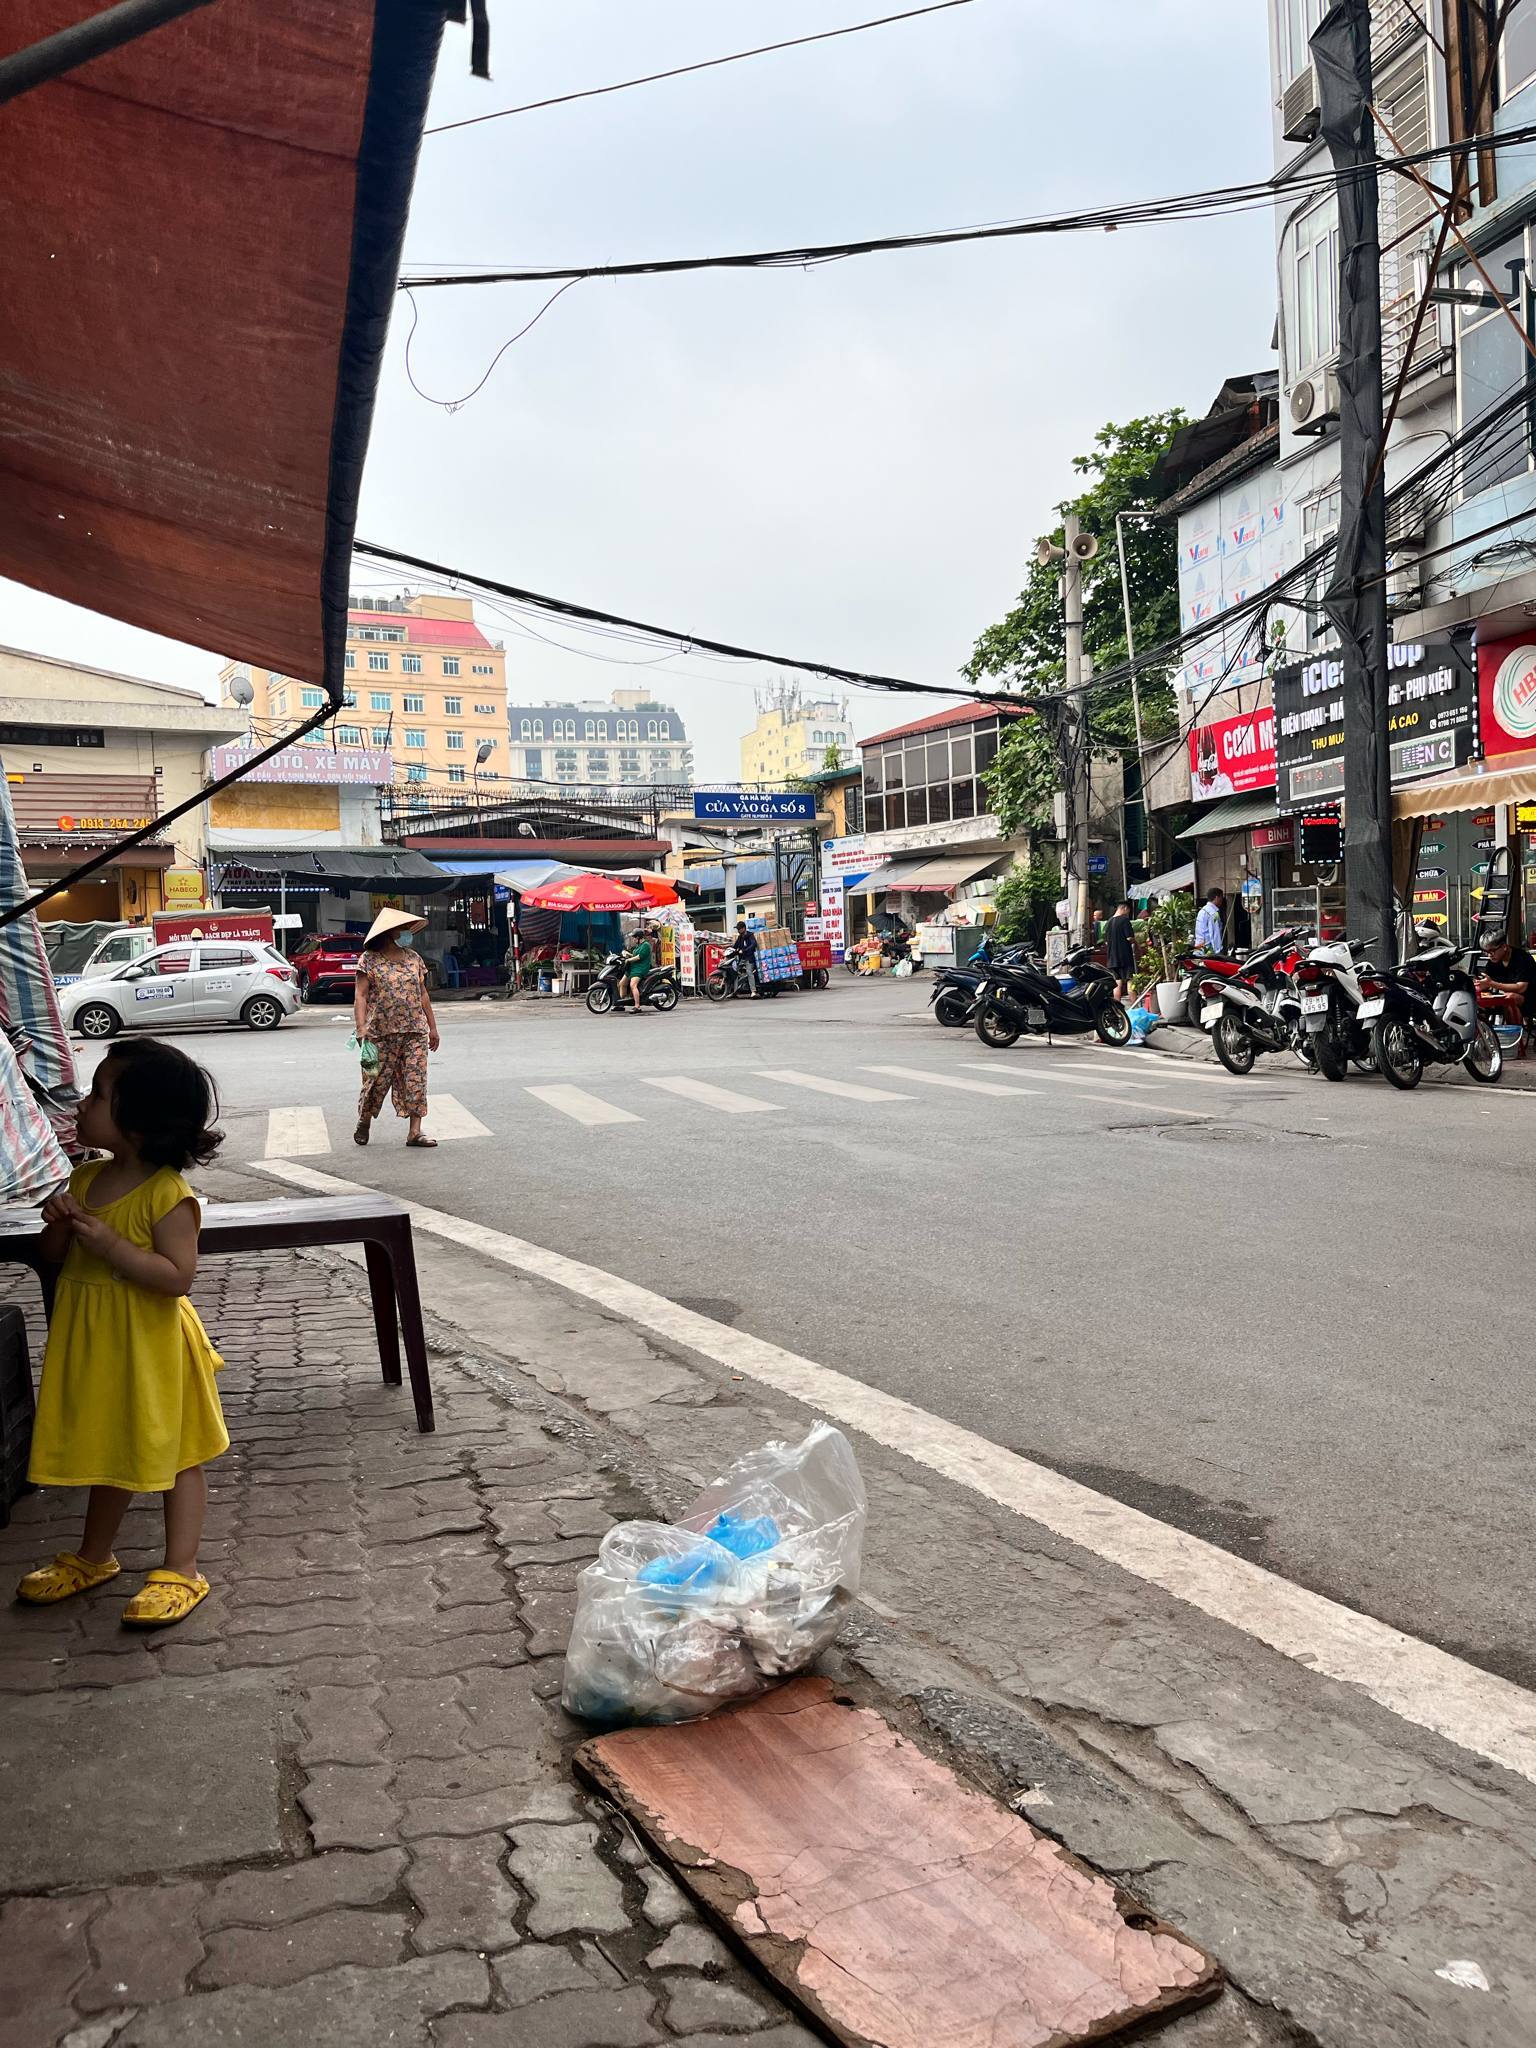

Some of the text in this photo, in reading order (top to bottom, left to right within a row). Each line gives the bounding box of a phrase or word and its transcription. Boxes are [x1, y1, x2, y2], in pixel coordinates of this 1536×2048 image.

[1399, 712, 1419, 728] CAO
[1223, 723, 1256, 760] CƠM
[1311, 737, 1327, 750] THU
[315, 756, 337, 769] XE
[344, 754, 381, 770] MÁY
[760, 795, 771, 803] NỘI
[705, 800, 805, 813] CỬA VÀO GA SỐ 8
[80, 819, 103, 829] 0913
[110, 819, 128, 829] 254
